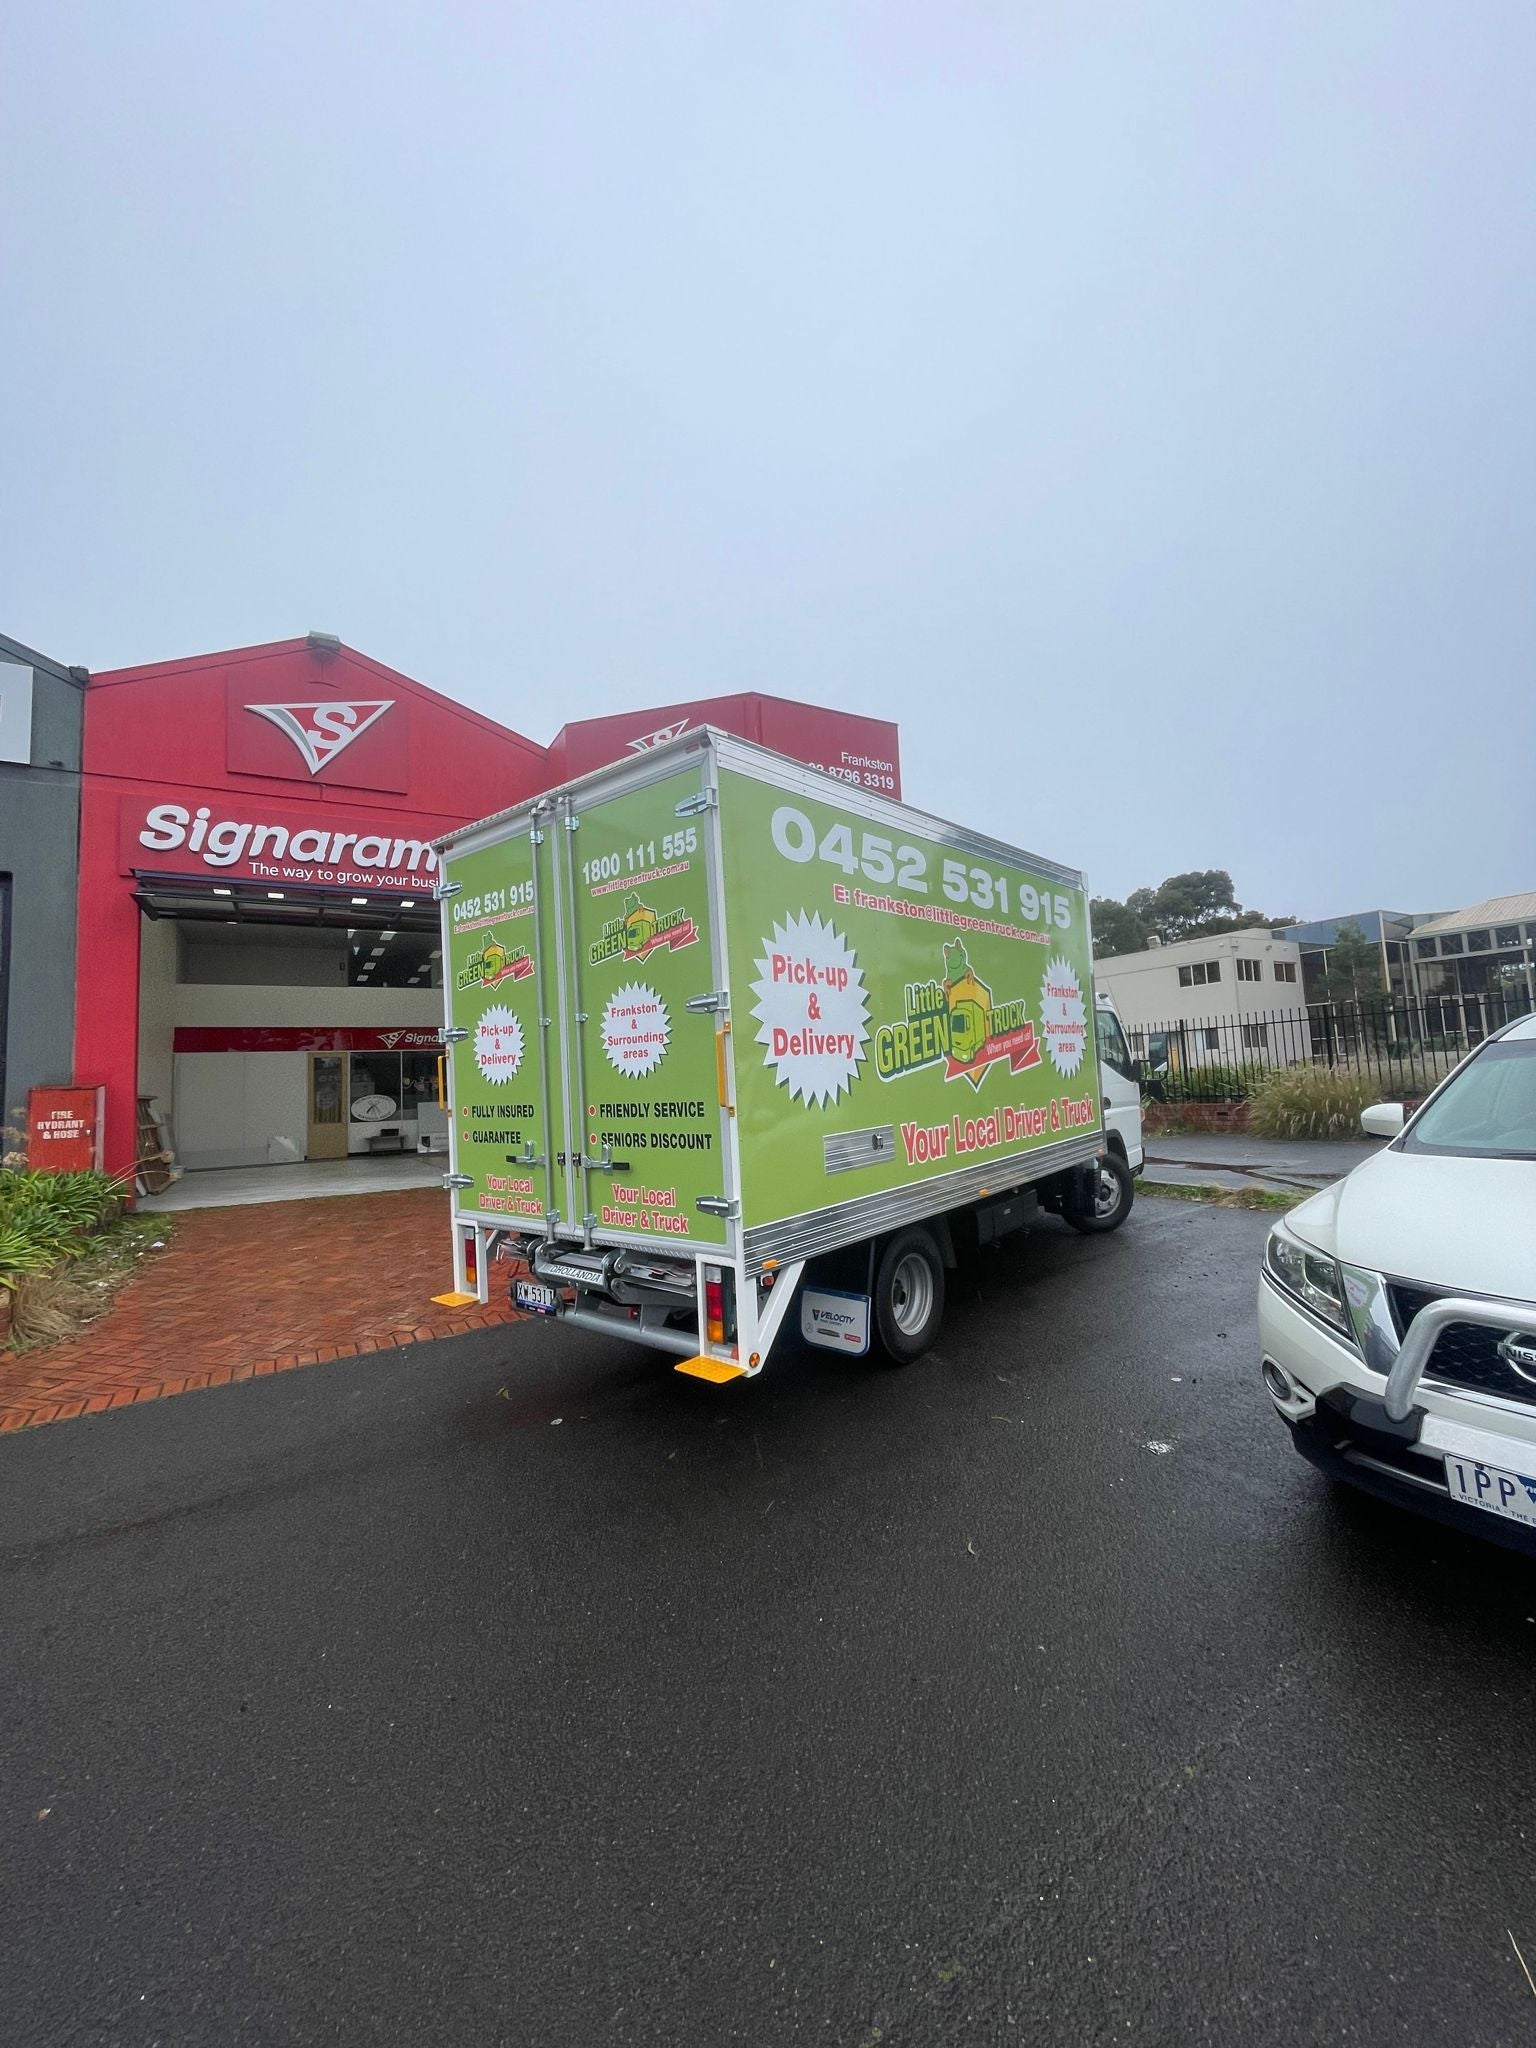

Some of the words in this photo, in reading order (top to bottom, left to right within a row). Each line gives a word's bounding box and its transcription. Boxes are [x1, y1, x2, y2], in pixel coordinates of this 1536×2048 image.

[841, 752, 893, 772] Frankston
[863, 773, 894, 790] 3319
[582, 852, 620, 885] 1800
[626, 840, 655, 872] 111
[662, 827, 697, 861] 555
[249, 862, 279, 877] The
[282, 868, 313, 882] way
[317, 869, 334, 881] to
[336, 872, 373, 885] grow
[376, 875, 409, 888] your
[771, 806, 928, 893] 0452
[942, 858, 1008, 914] 531
[1019, 884, 1071, 930] 915
[591, 860, 690, 897] www.littlegreentruck.com.au
[454, 897, 482, 922] 0452
[484, 889, 506, 913] 531
[510, 880, 534, 906] 915
[832, 884, 850, 906] E:
[853, 889, 1051, 945] frankston@littlegreentruck.com.au
[590, 931, 627, 963] GREEN
[651, 909, 685, 937] TRUCK
[602, 918, 625, 940] Little
[458, 962, 485, 988] GREEN
[772, 954, 848, 992] Pick-up
[906, 981, 944, 1013] Little
[1046, 983, 1078, 999] Frankston
[611, 1004, 657, 1018] Frankston
[808, 992, 821, 1020] &
[1062, 1003, 1067, 1016] &
[481, 1025, 514, 1037] Pick-up
[631, 1019, 637, 1029] &
[1046, 1021, 1084, 1036] Surrounding
[495, 1038, 501, 1050] &
[608, 1032, 664, 1046] Surrounding
[773, 1028, 854, 1058] Delivery
[876, 1013, 950, 1076] GREEN
[986, 1001, 1025, 1036] TRUCK
[1058, 1043, 1076, 1053] areas
[481, 1053, 516, 1066] Delivery
[623, 1049, 648, 1059] areas
[472, 1105, 495, 1118] FULLY
[497, 1105, 534, 1118] INSURED
[600, 1103, 650, 1118] FRIENDLY
[654, 1102, 705, 1117] SERVICE
[37, 1119, 84, 1129] HYDRANT
[900, 1121, 949, 1166] Your
[953, 1108, 1001, 1153] Local
[1004, 1103, 1047, 1142] Driver
[1049, 1099, 1061, 1132] &
[1061, 1093, 1095, 1126] Truck
[42, 1131, 51, 1139] &
[53, 1130, 79, 1139] HOSE
[473, 1130, 521, 1144] GUARANTEE
[601, 1132, 647, 1148] SENIORS
[651, 1133, 712, 1149] DISCOUNT
[486, 1173, 507, 1191] Your
[508, 1176, 533, 1194] Local
[479, 1192, 506, 1211] Driver
[507, 1196, 515, 1212] &
[516, 1198, 543, 1215] Truck
[612, 1184, 639, 1204] Your
[641, 1186, 676, 1207] Local
[602, 1206, 638, 1227] Driver
[640, 1210, 650, 1230] &
[651, 1211, 689, 1234] Truck
[550, 1264, 602, 1283] DHOLLANDIA
[820, 1311, 855, 1324] VELOCITY
[1455, 1464, 1516, 1507] 1PP
[1459, 1494, 1501, 1512] VICTORIA
[1510, 1511, 1528, 1522] THE
